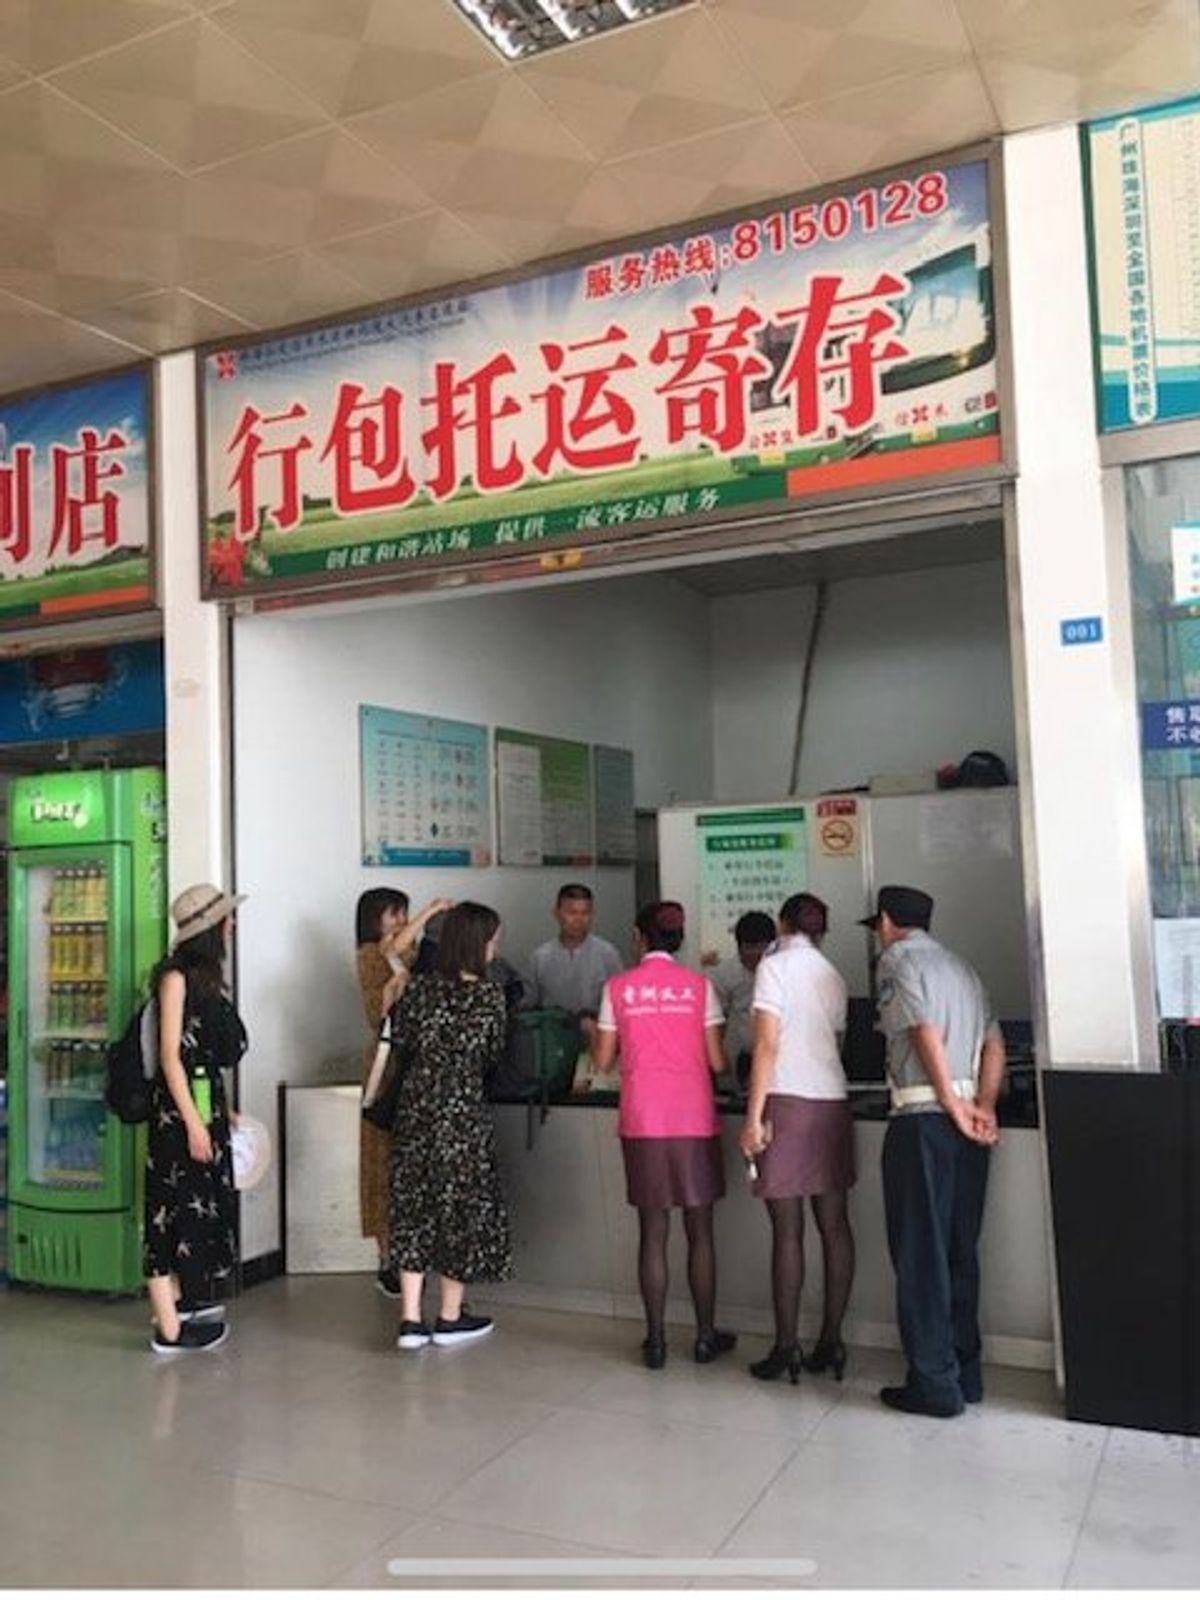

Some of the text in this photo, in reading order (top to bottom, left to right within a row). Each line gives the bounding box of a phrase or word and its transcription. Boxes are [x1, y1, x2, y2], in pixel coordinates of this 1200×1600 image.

[228, 273, 910, 536] 行包托运寄存
